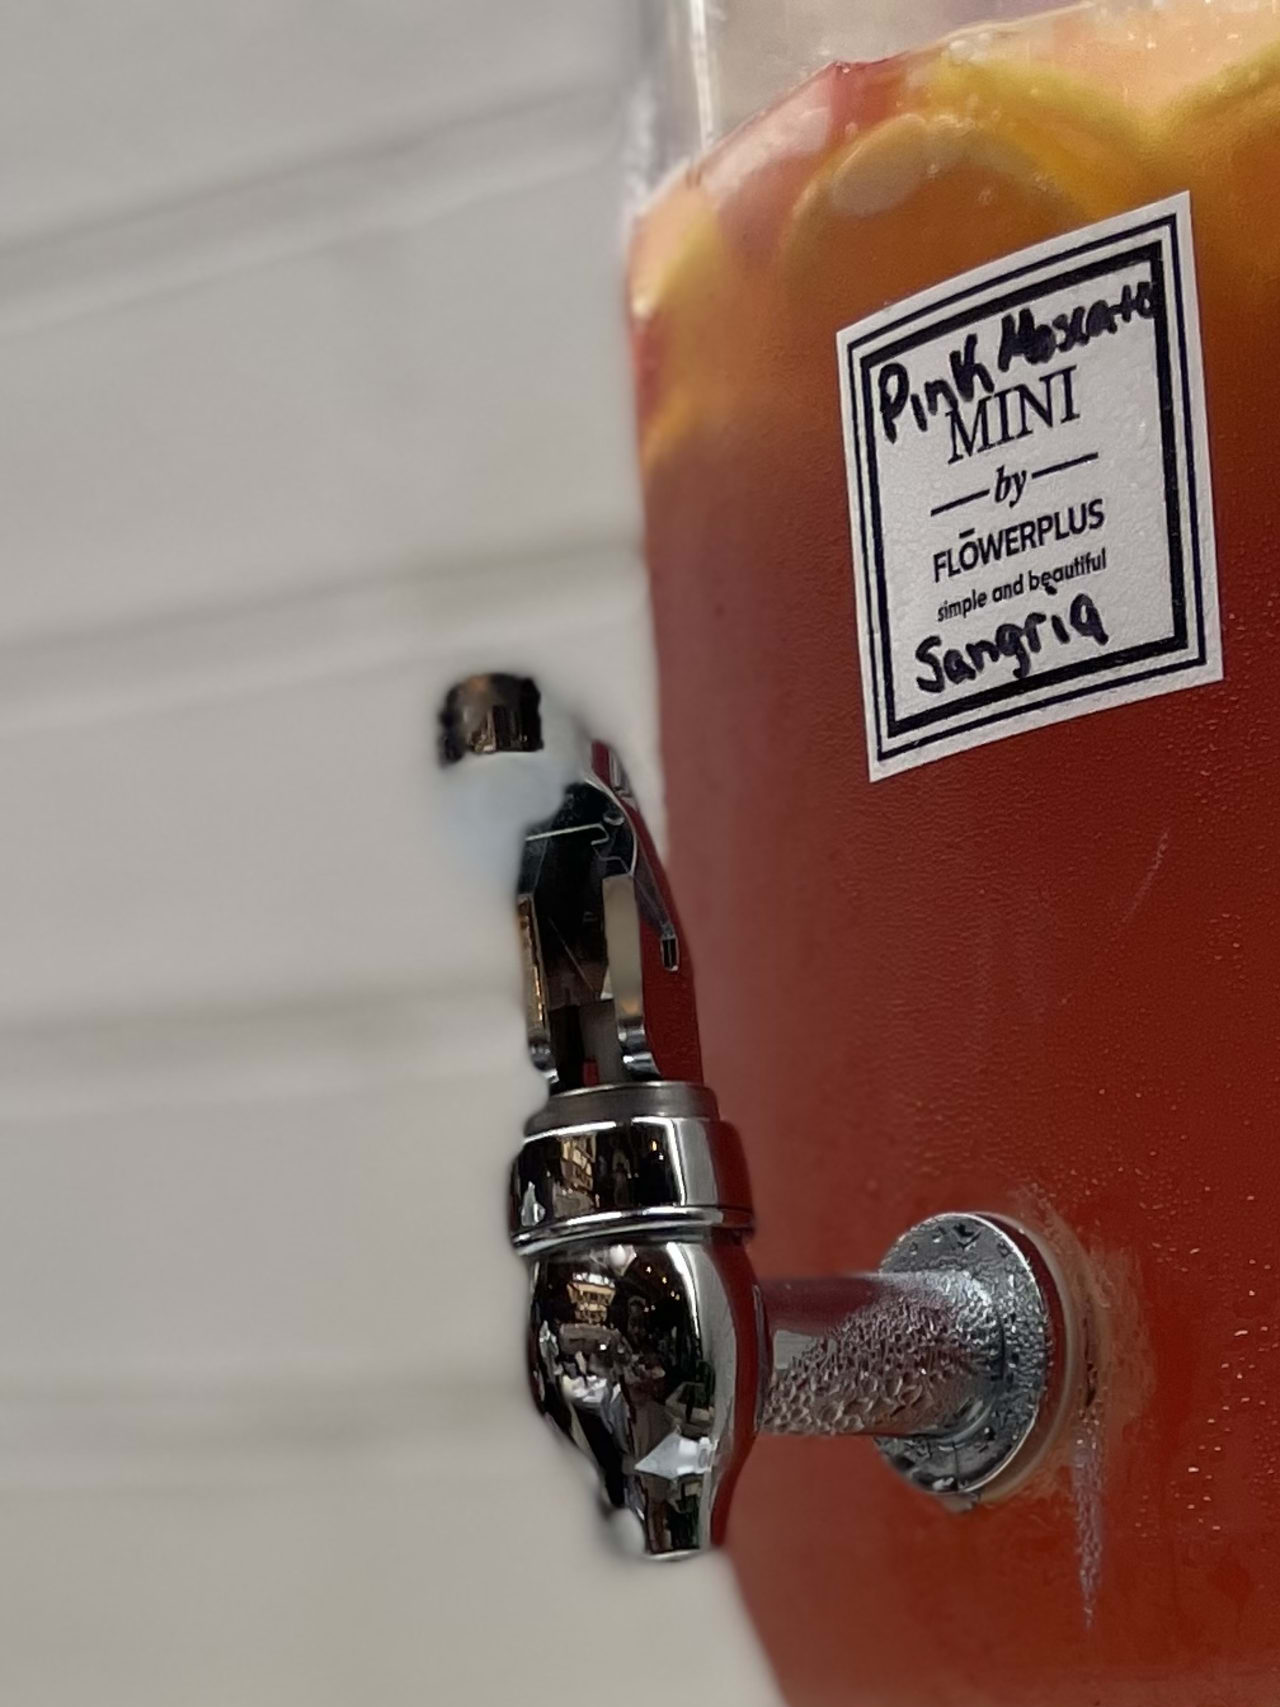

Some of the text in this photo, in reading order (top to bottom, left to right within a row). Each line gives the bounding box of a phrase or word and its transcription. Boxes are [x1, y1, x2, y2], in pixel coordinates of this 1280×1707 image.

[878, 334, 994, 443] Pink
[946, 365, 1080, 464] MINI
[994, 466, 1027, 508] by
[937, 548, 1107, 622] simple and beautiful
[916, 584, 1108, 693] Sangria
